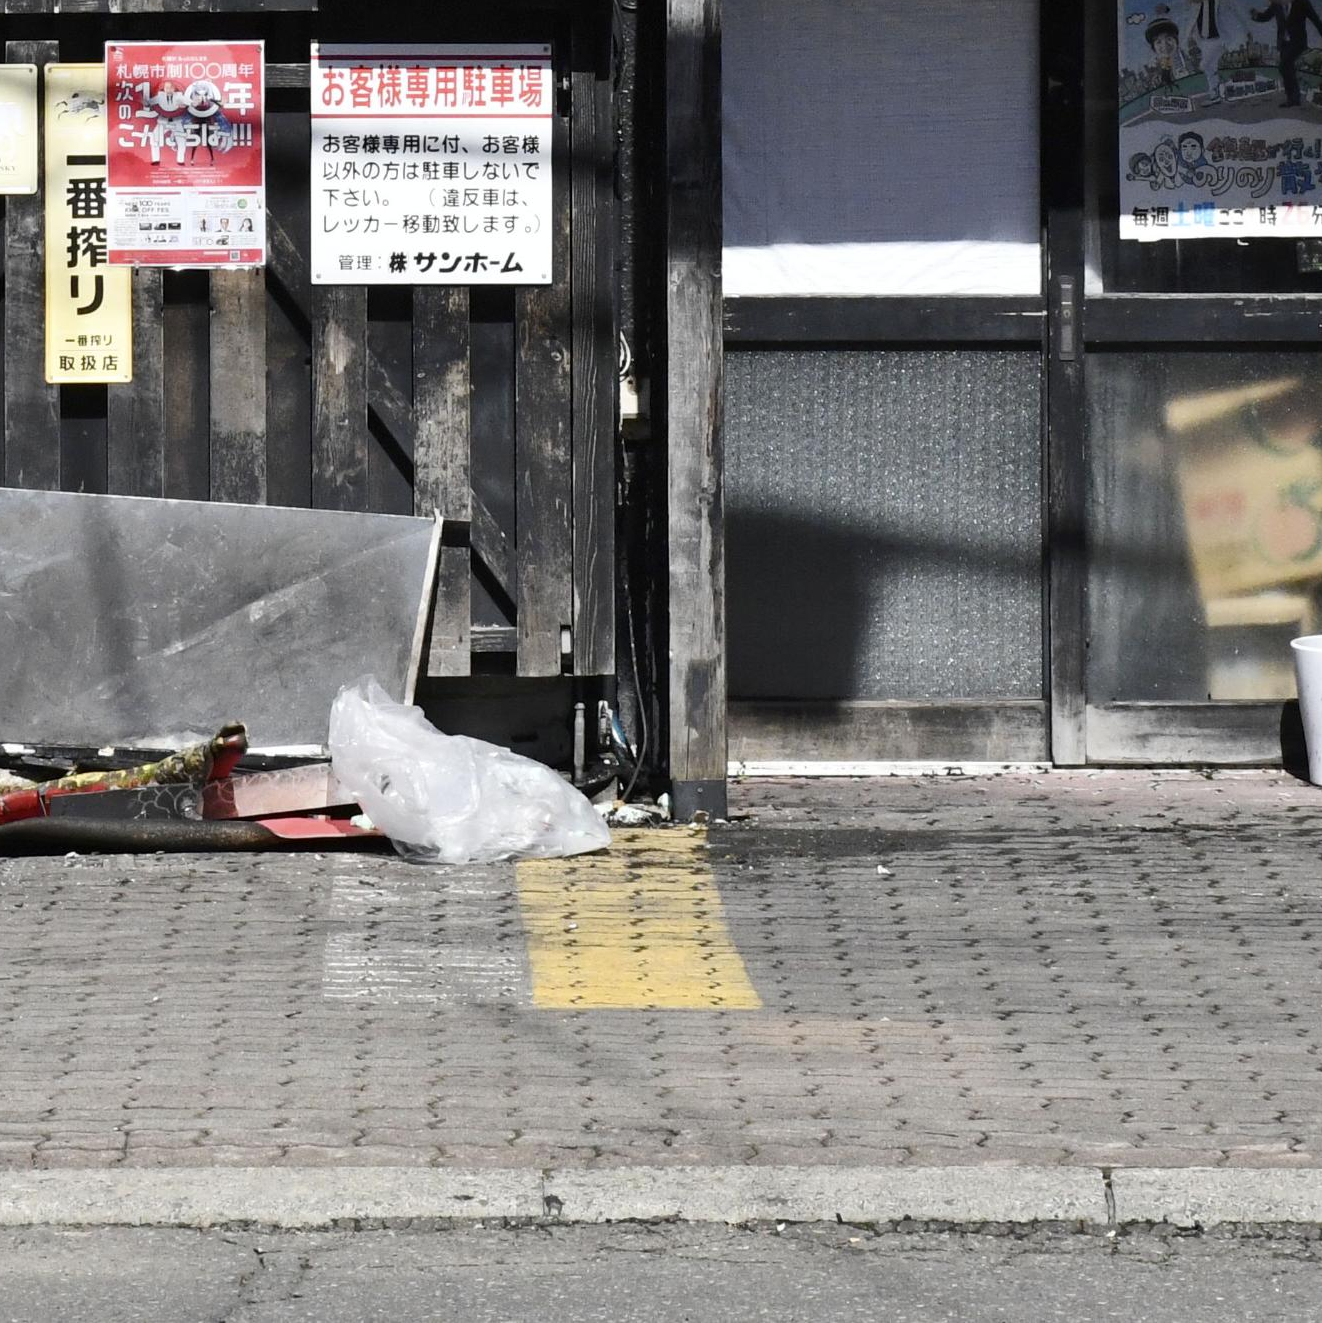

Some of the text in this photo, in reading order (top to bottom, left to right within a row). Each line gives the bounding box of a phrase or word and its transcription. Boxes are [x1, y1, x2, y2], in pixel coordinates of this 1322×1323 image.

[115, 62, 254, 79] 札幌市制100周年
[322, 64, 543, 108] お客様専用駐車場
[322, 134, 540, 154] お客様専用に付、お客様
[322, 161, 540, 180] 以外の方は駐車しないで
[322, 188, 390, 207] 下さい。
[66, 154, 107, 317] 一番搾り
[64, 334, 113, 347] 一番搾り
[59, 355, 118, 371] 取扱店
